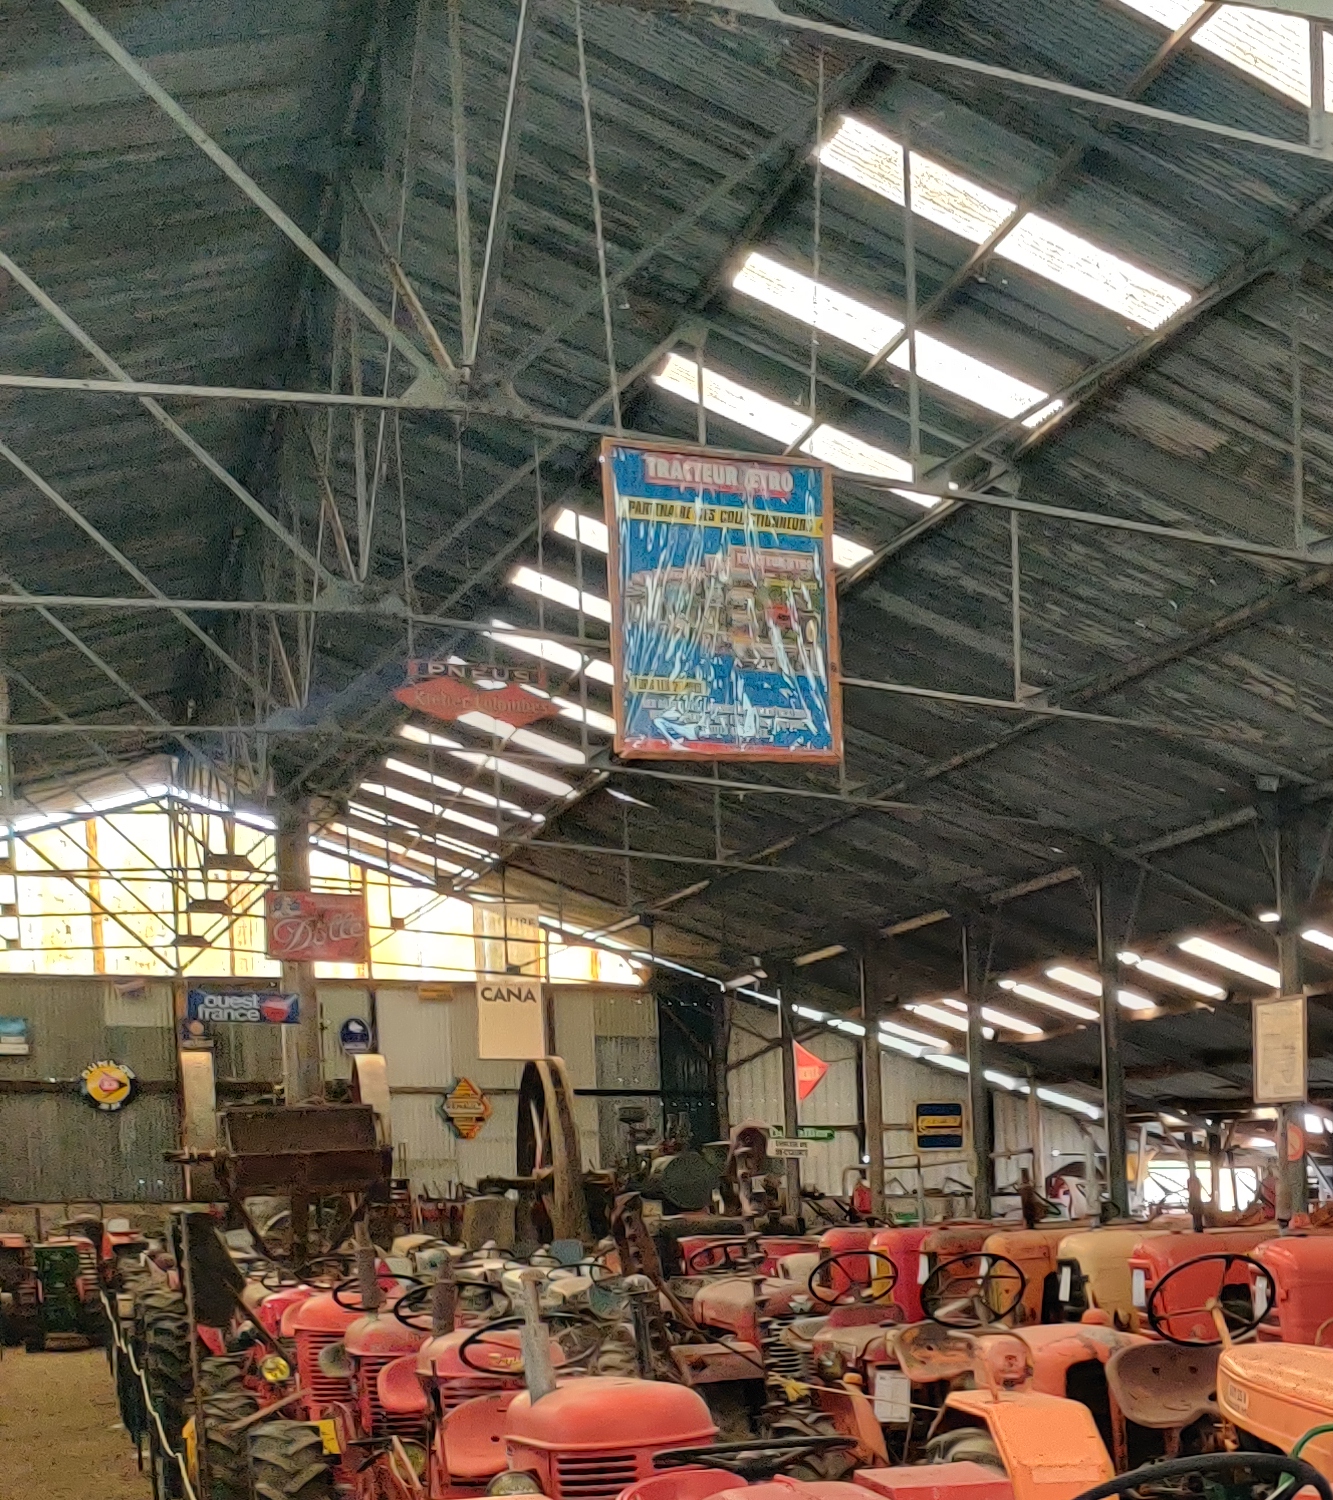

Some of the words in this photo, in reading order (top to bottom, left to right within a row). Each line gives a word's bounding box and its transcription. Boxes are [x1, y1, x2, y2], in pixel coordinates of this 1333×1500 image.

[644, 456, 738, 487] TRACTEUR
[428, 660, 530, 682] PNEUS
[203, 995, 260, 1008] ouest
[480, 986, 537, 1004] CANA
[198, 1005, 260, 1022] france
